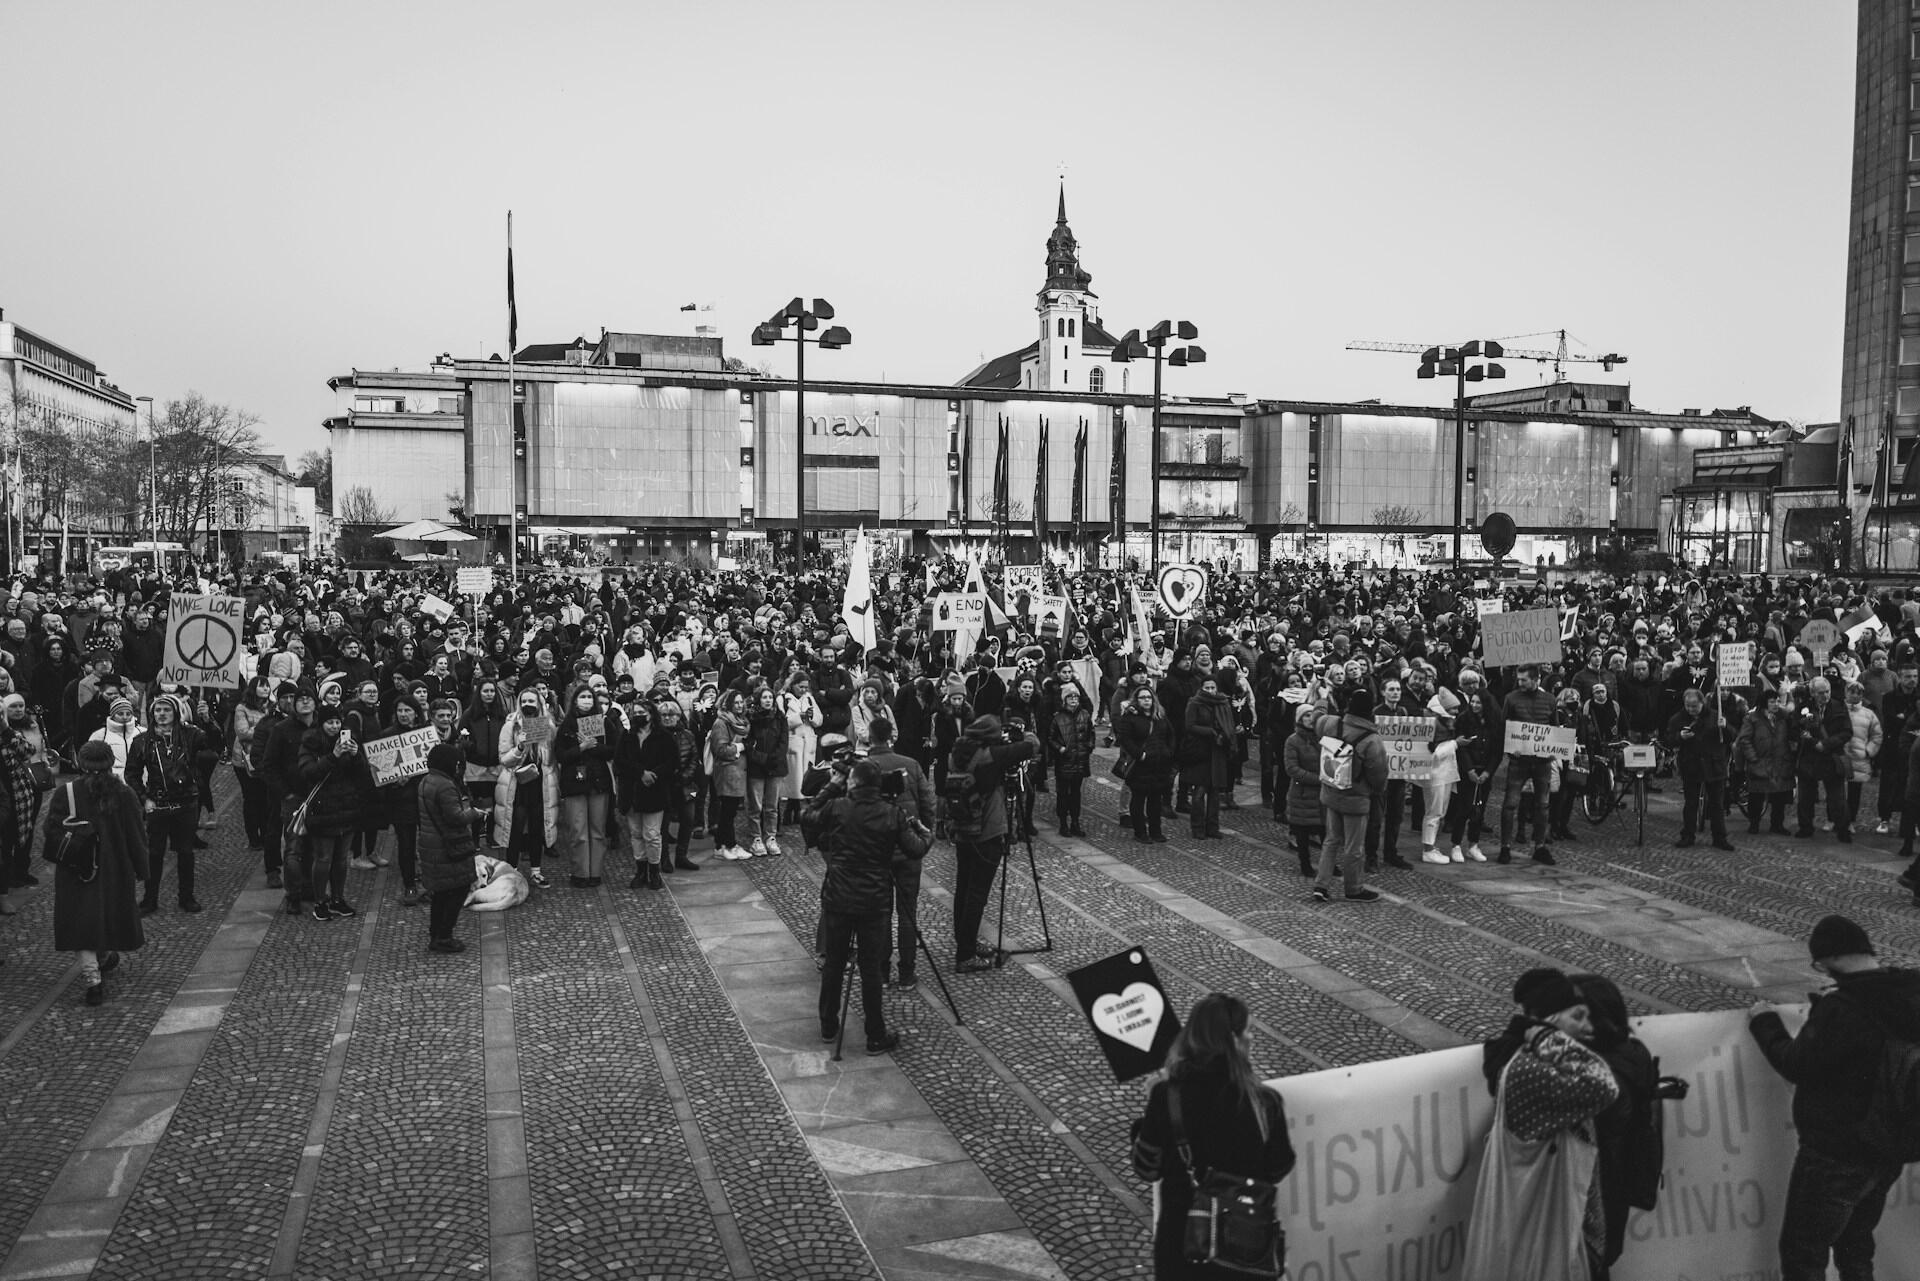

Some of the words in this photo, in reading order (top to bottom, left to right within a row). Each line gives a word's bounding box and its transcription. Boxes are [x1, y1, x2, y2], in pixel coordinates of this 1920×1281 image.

[804, 410, 879, 437] maxi
[1009, 566, 1041, 578] PROTECT
[171, 597, 204, 622] MAKE
[209, 598, 242, 618] LOVE
[956, 599, 984, 611] END
[955, 616, 965, 624] TO
[968, 616, 982, 624] WAR
[1486, 627, 1553, 648] PUTINOVO
[166, 665, 193, 682] NOT
[201, 670, 235, 684] WAR
[1725, 676, 1747, 685] NATO
[1521, 723, 1552, 735] PUTIN
[367, 739, 400, 755] MAKE
[403, 730, 434, 747] LOVE
[1394, 739, 1413, 752] GO
[1534, 743, 1569, 756] UKRAINE
[1388, 755, 1407, 771] CK
